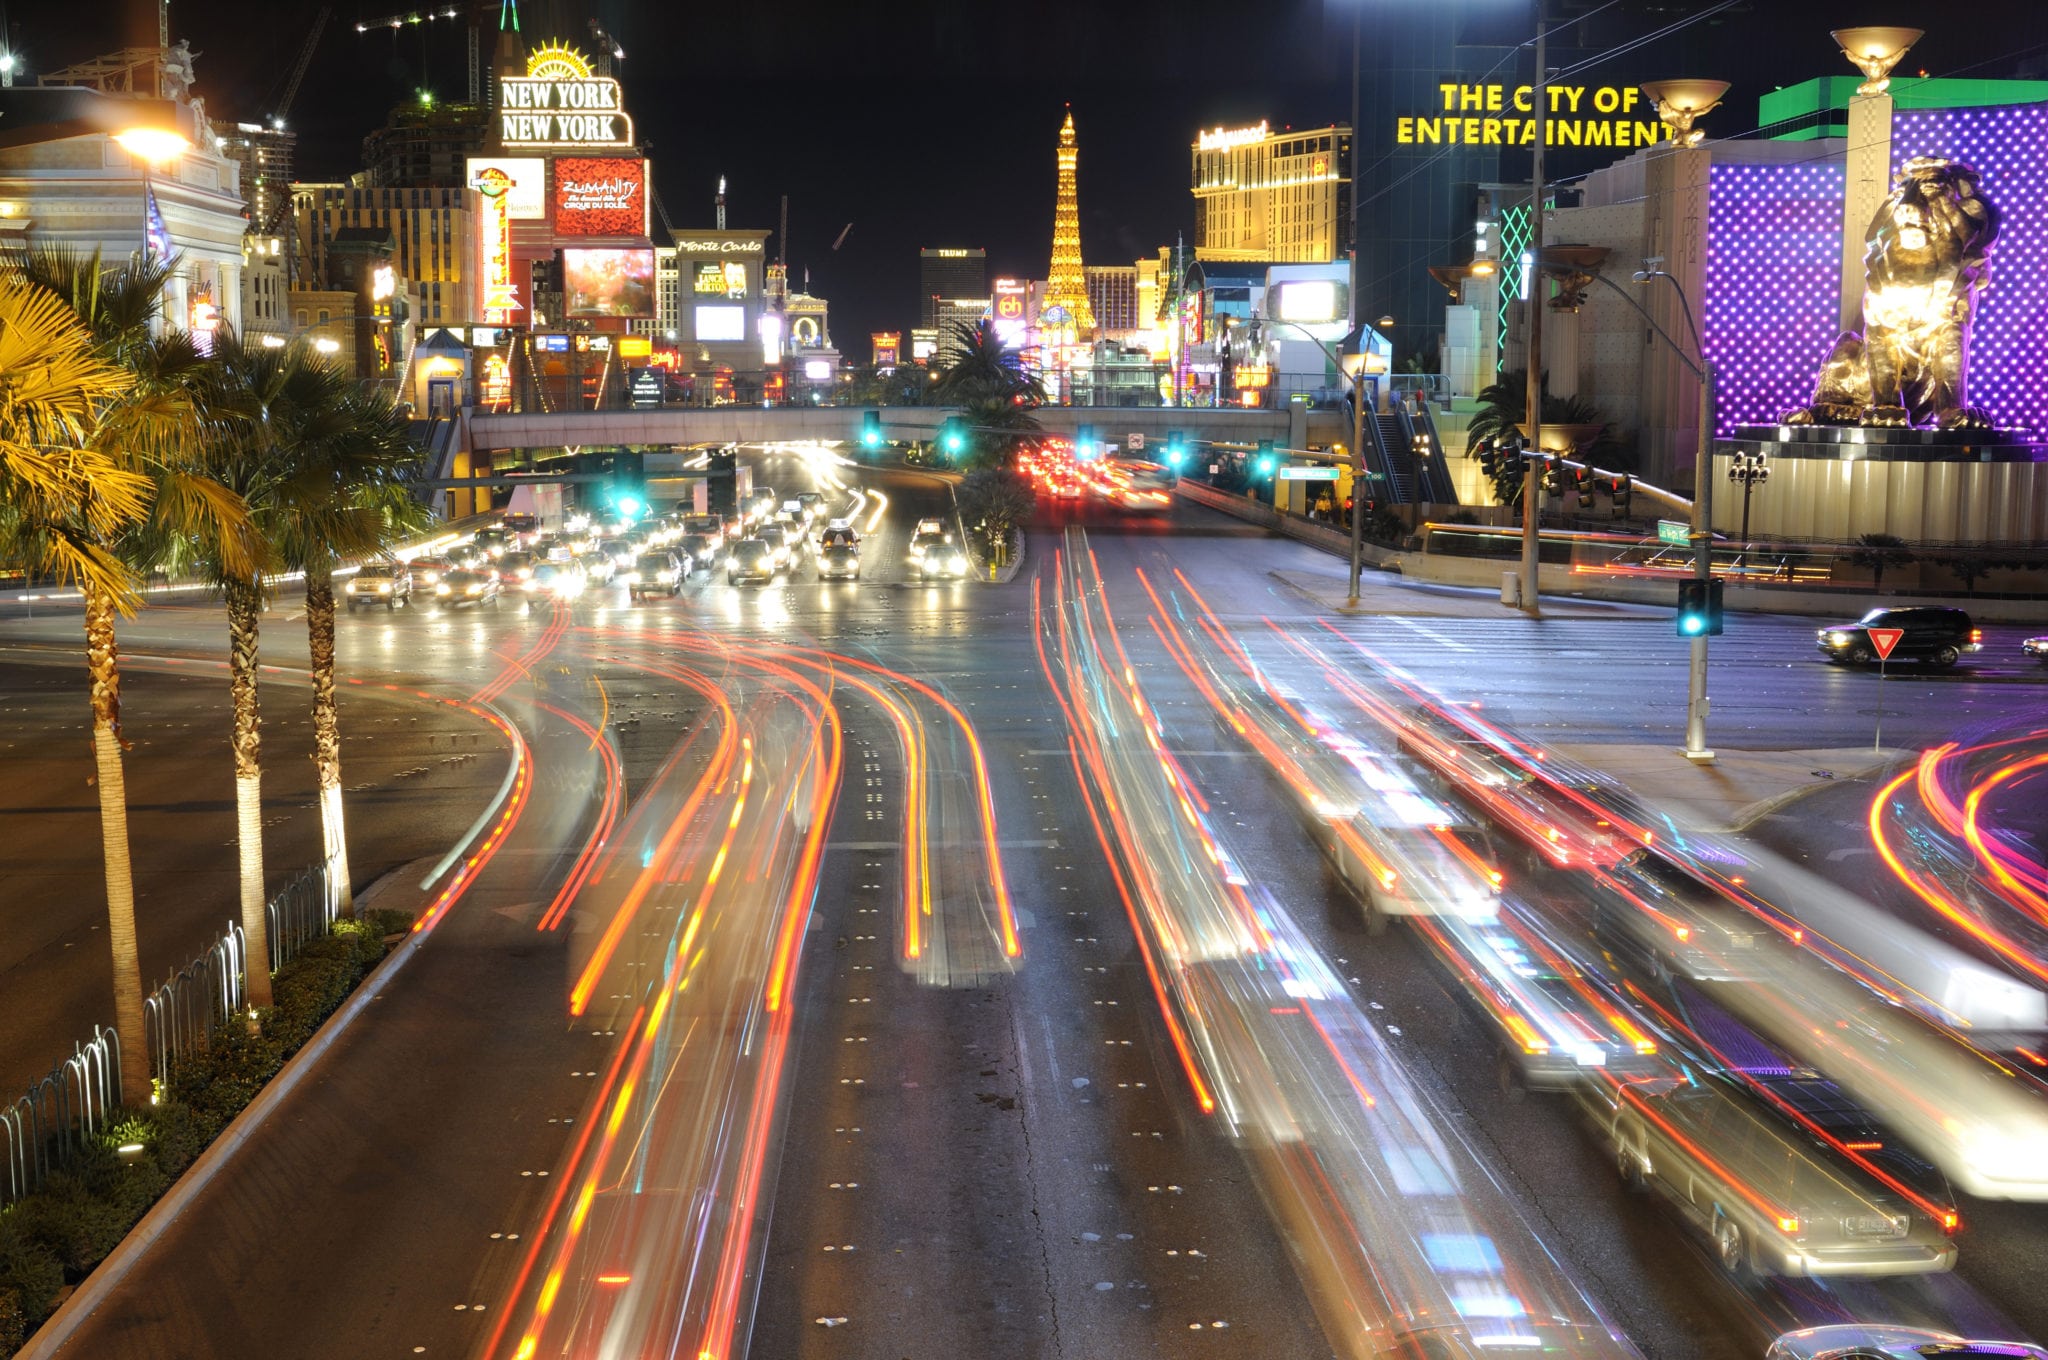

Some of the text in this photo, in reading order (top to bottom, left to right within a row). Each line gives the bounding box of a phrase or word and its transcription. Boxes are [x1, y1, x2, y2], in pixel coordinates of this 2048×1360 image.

[502, 83, 616, 108] NEW YORK
[1440, 84, 1639, 113] THE CTY OF
[502, 115, 616, 140] NEW YORK
[1199, 120, 1266, 153] hollywood
[1397, 118, 1674, 147] ENTERTAINMENT
[562, 177, 639, 199] ZUMANITY
[563, 202, 591, 210] CIRQUE
[677, 241, 762, 252] Monte Carlo
[694, 282, 727, 292] BURTON
[699, 274, 724, 283] LANCE
[1001, 296, 1022, 315] ph
